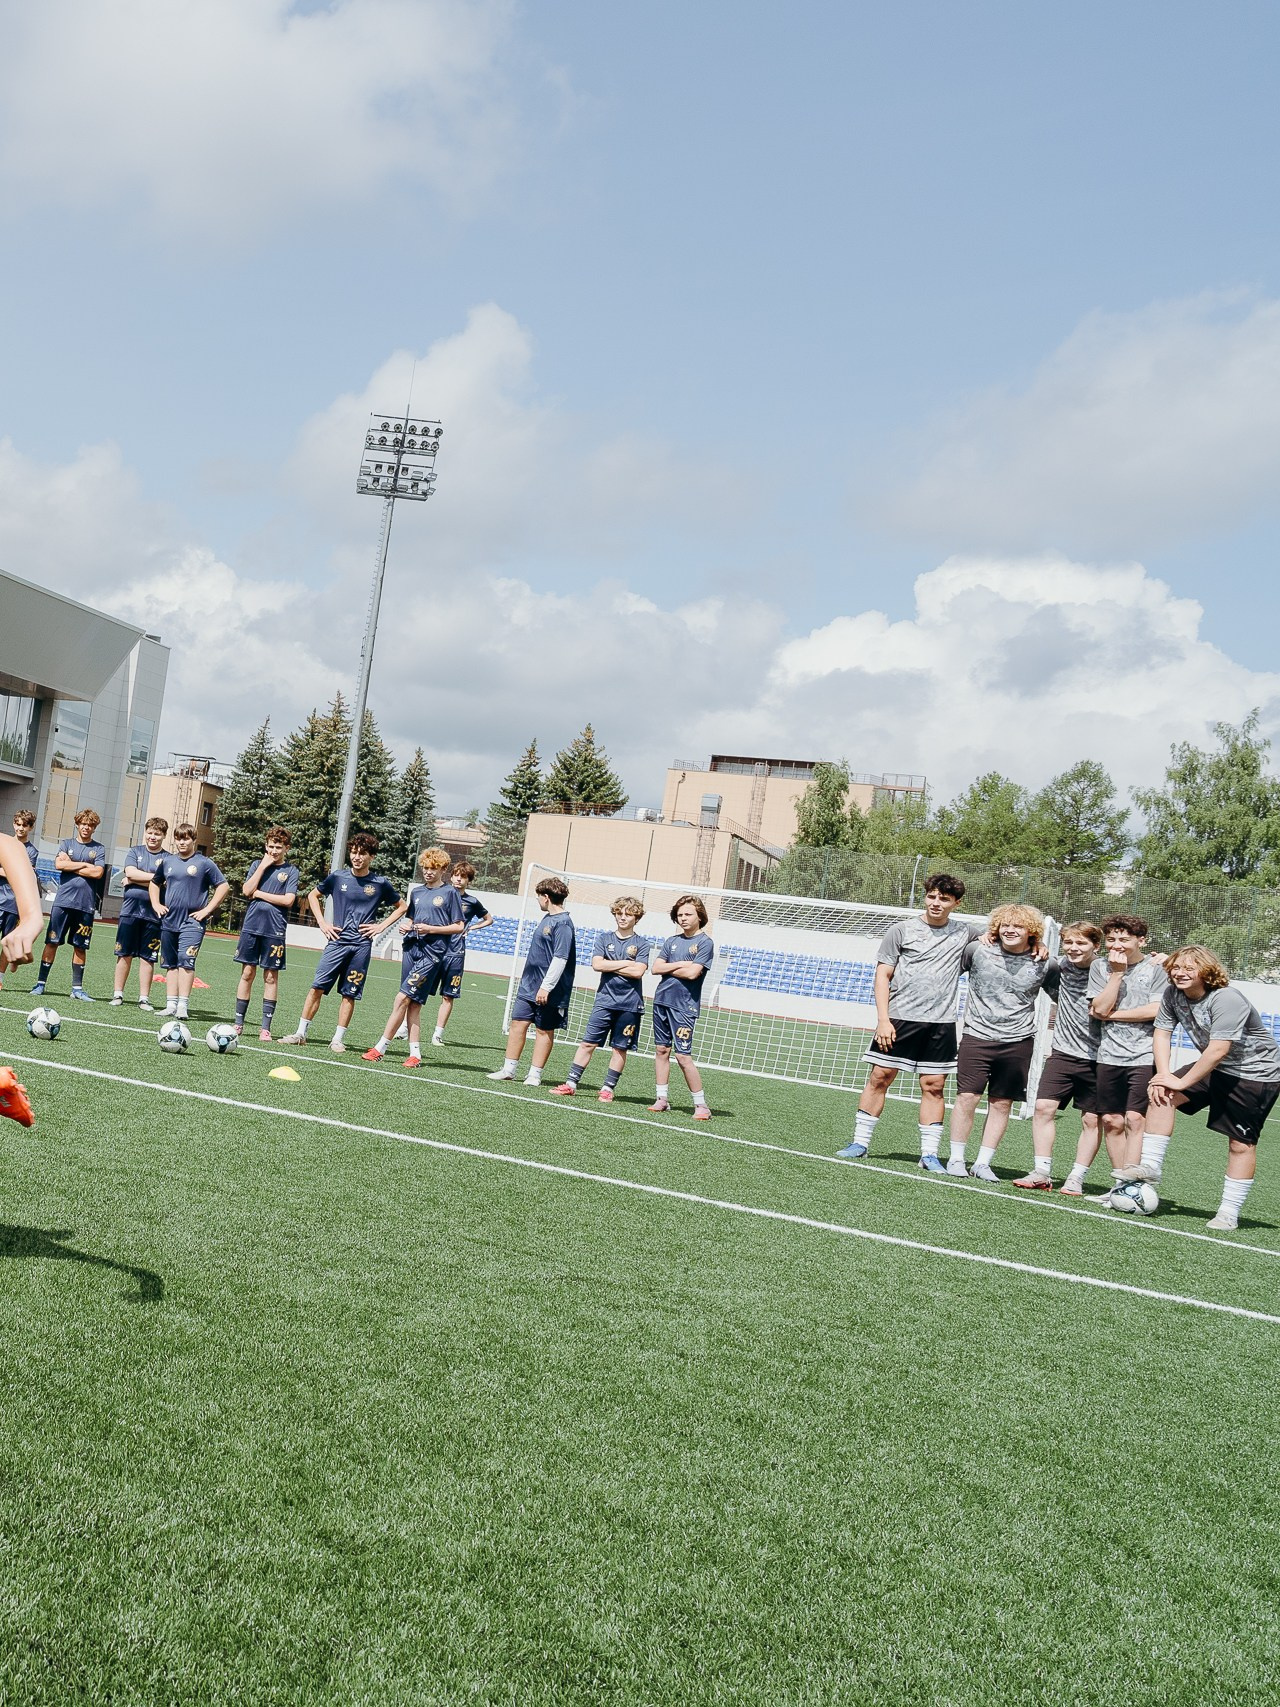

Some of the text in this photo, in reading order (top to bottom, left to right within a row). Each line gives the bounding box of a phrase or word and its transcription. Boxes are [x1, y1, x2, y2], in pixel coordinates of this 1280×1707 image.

[270, 944, 285, 958] 70
[347, 970, 364, 985] 22
[450, 975, 462, 987] 18
[676, 1026, 692, 1040] 45
